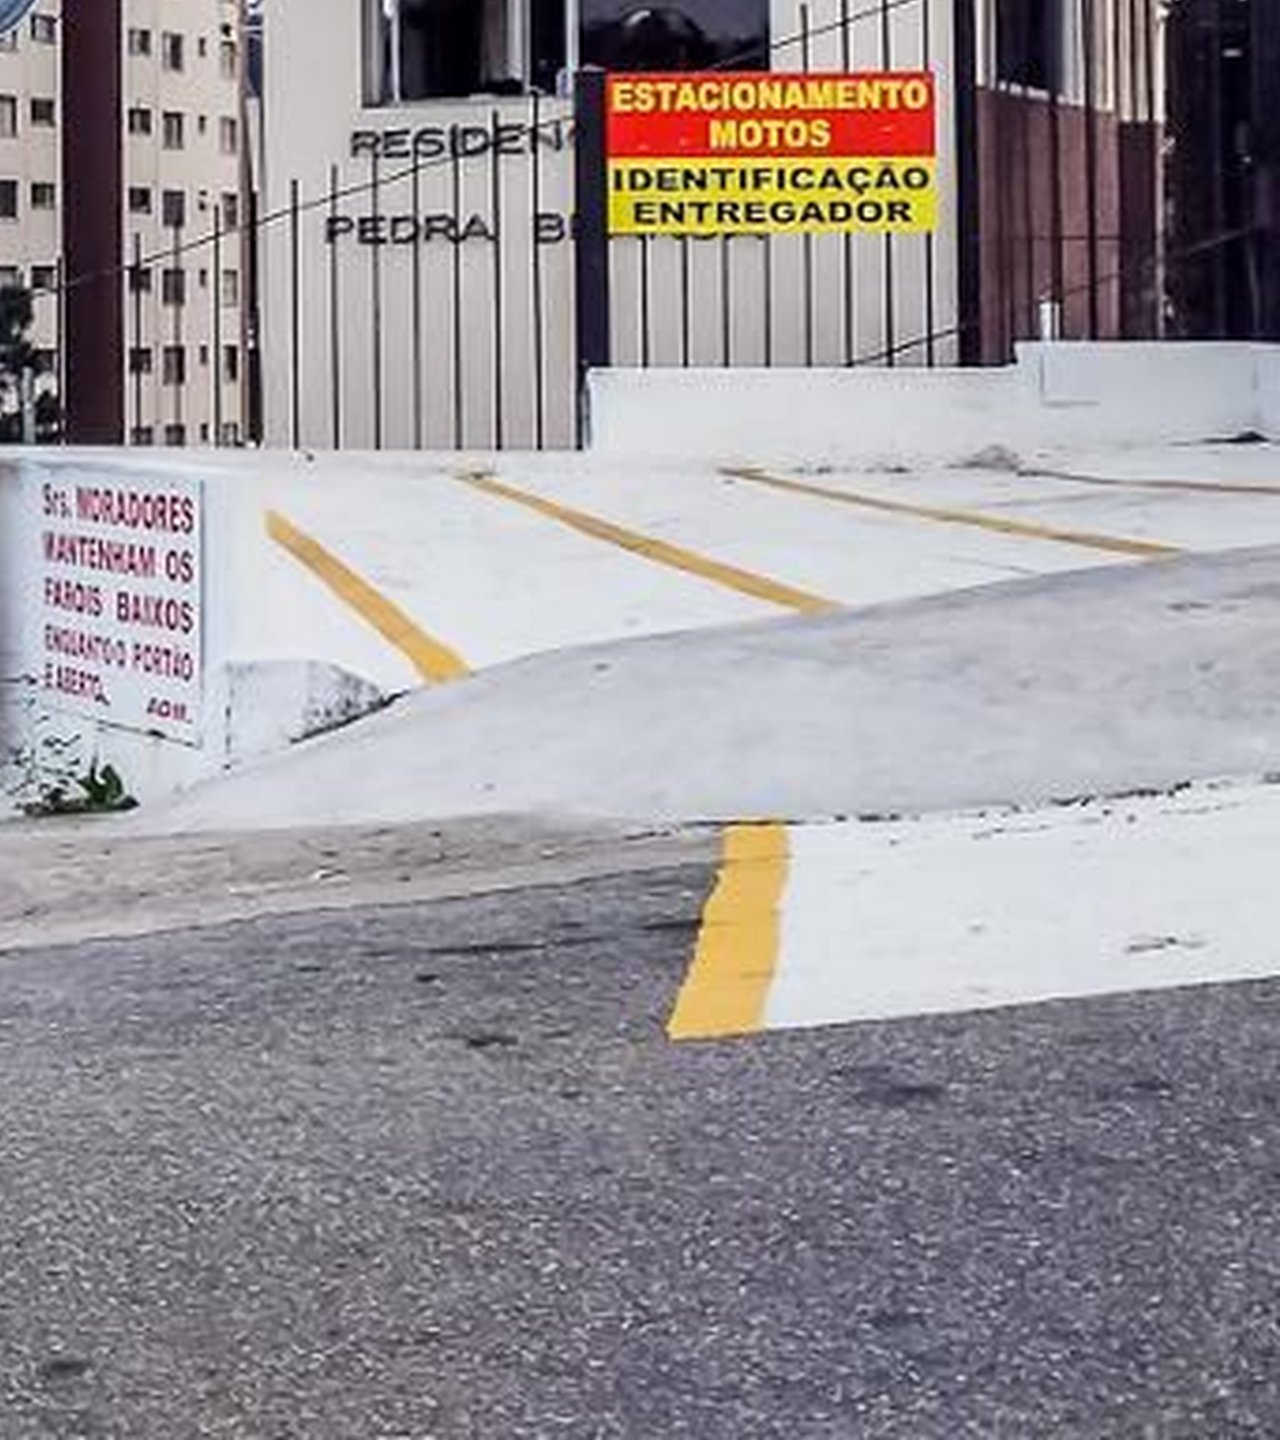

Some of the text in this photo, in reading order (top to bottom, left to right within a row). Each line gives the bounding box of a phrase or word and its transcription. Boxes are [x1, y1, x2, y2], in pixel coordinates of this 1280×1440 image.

[612, 81, 928, 111] ESTACIONAMENTO
[350, 120, 577, 158] RESIDEN
[709, 119, 832, 149] MOTOS
[613, 161, 930, 196] IDENTIFICAÇÃO
[325, 213, 497, 244] PEDRA
[632, 201, 912, 224] ENTREGADOR
[76, 486, 194, 535] MORADORES
[43, 532, 194, 583] MANTENHAM OS
[116, 592, 194, 634] BAIXOS
